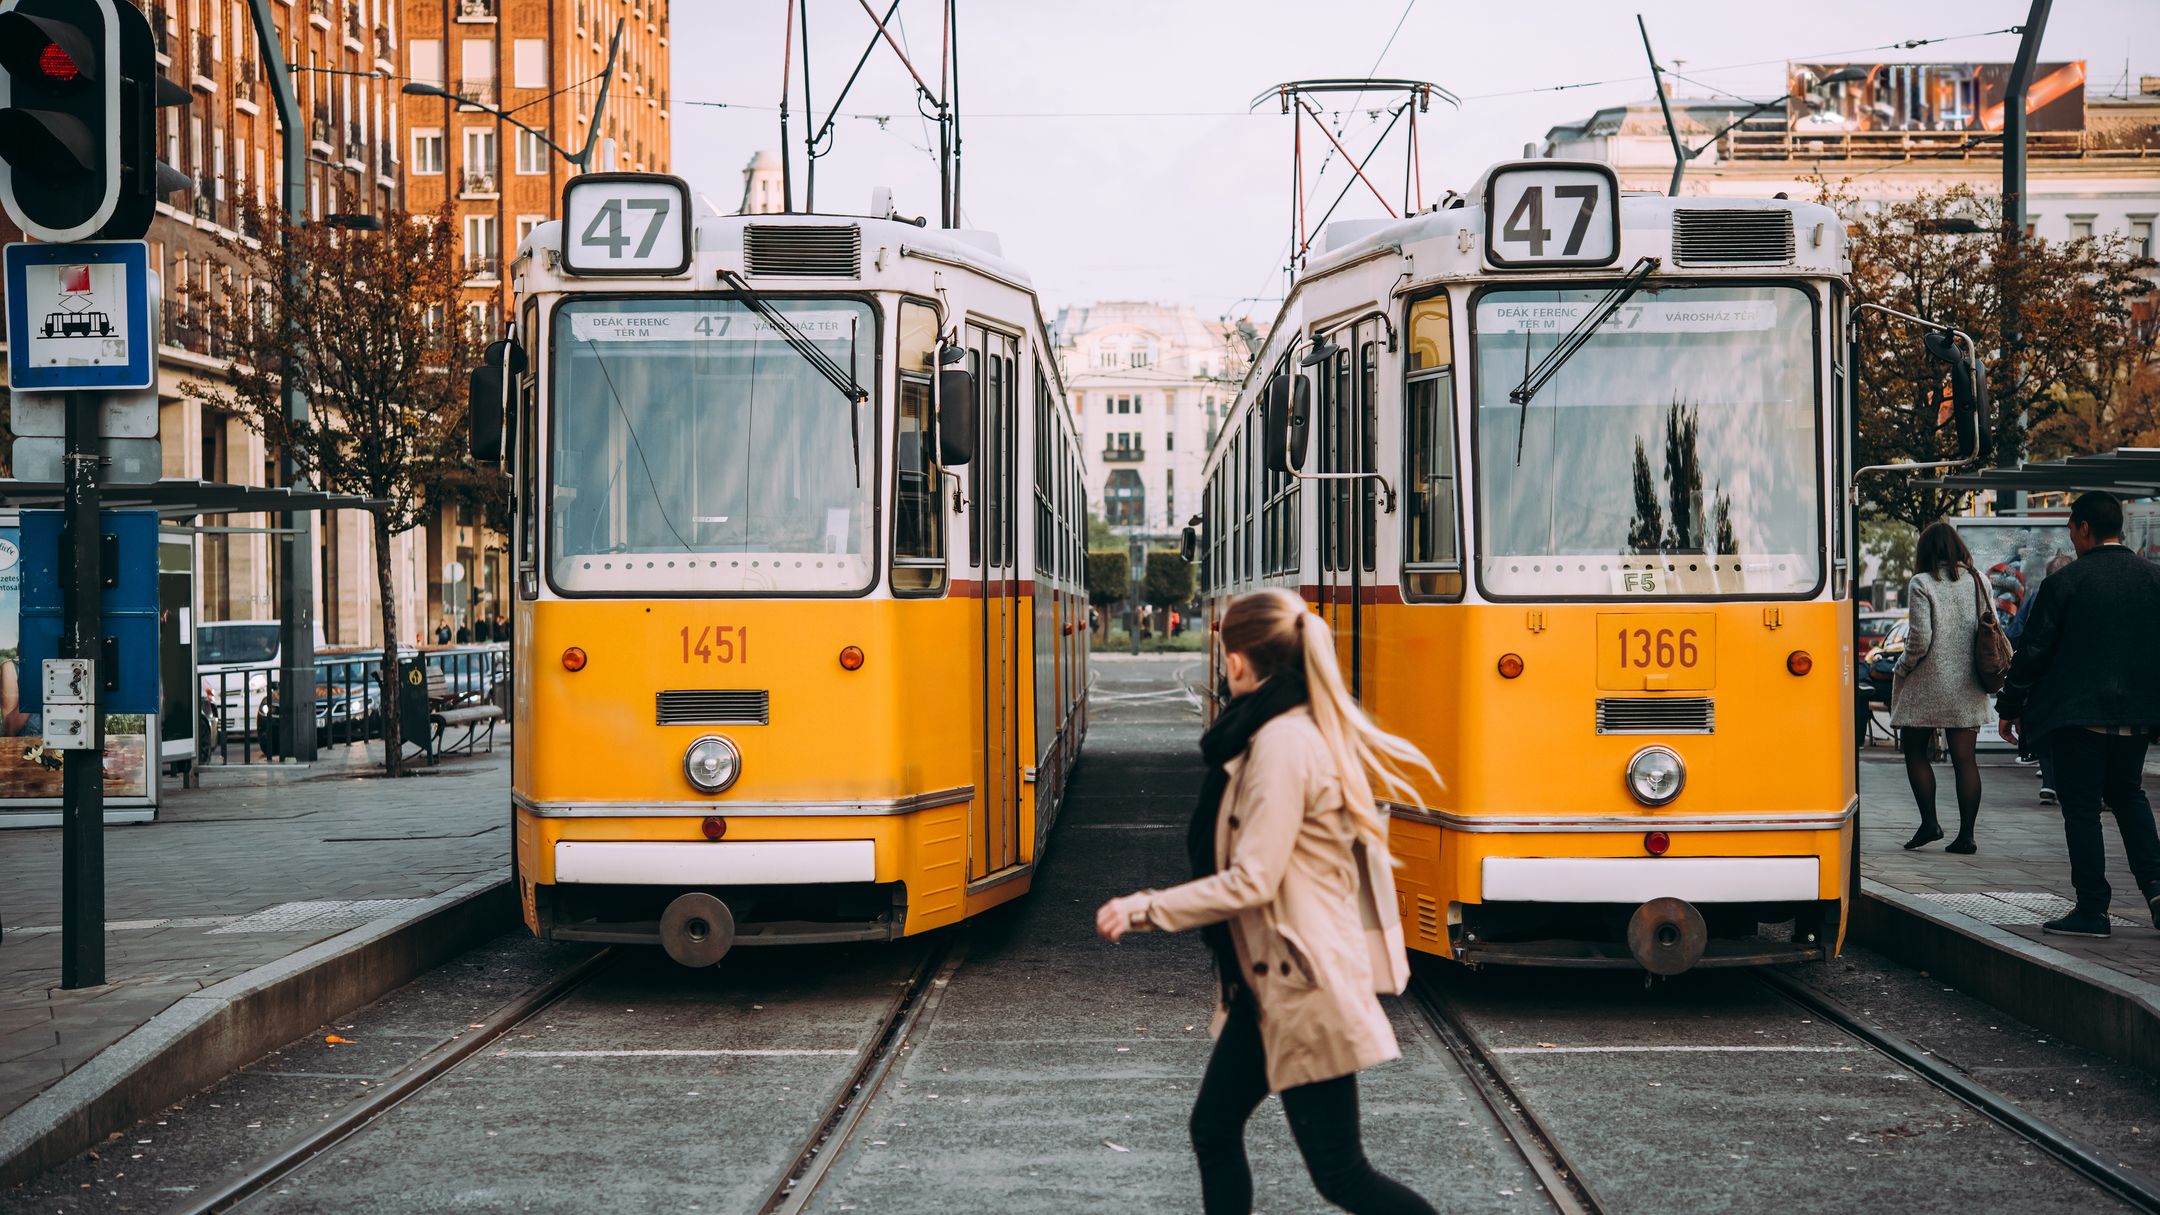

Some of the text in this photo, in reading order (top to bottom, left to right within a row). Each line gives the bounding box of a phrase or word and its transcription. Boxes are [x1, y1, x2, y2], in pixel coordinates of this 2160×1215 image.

[581, 198, 670, 258] 47
[1503, 185, 1599, 257] 47
[593, 316, 670, 327] DEÁK FERENC
[1497, 307, 1578, 318] DEÁK FERENC
[1602, 306, 1644, 329] 47
[1665, 311, 1730, 322] VÁROSHÁZ
[614, 326, 650, 337] TÉR M
[694, 315, 732, 337] 47
[818, 319, 839, 331] TÉR
[1518, 319, 1555, 329] TÉR M
[1624, 573, 1656, 592] F5
[680, 626, 747, 664] 1451
[1618, 628, 1698, 669] 1366
